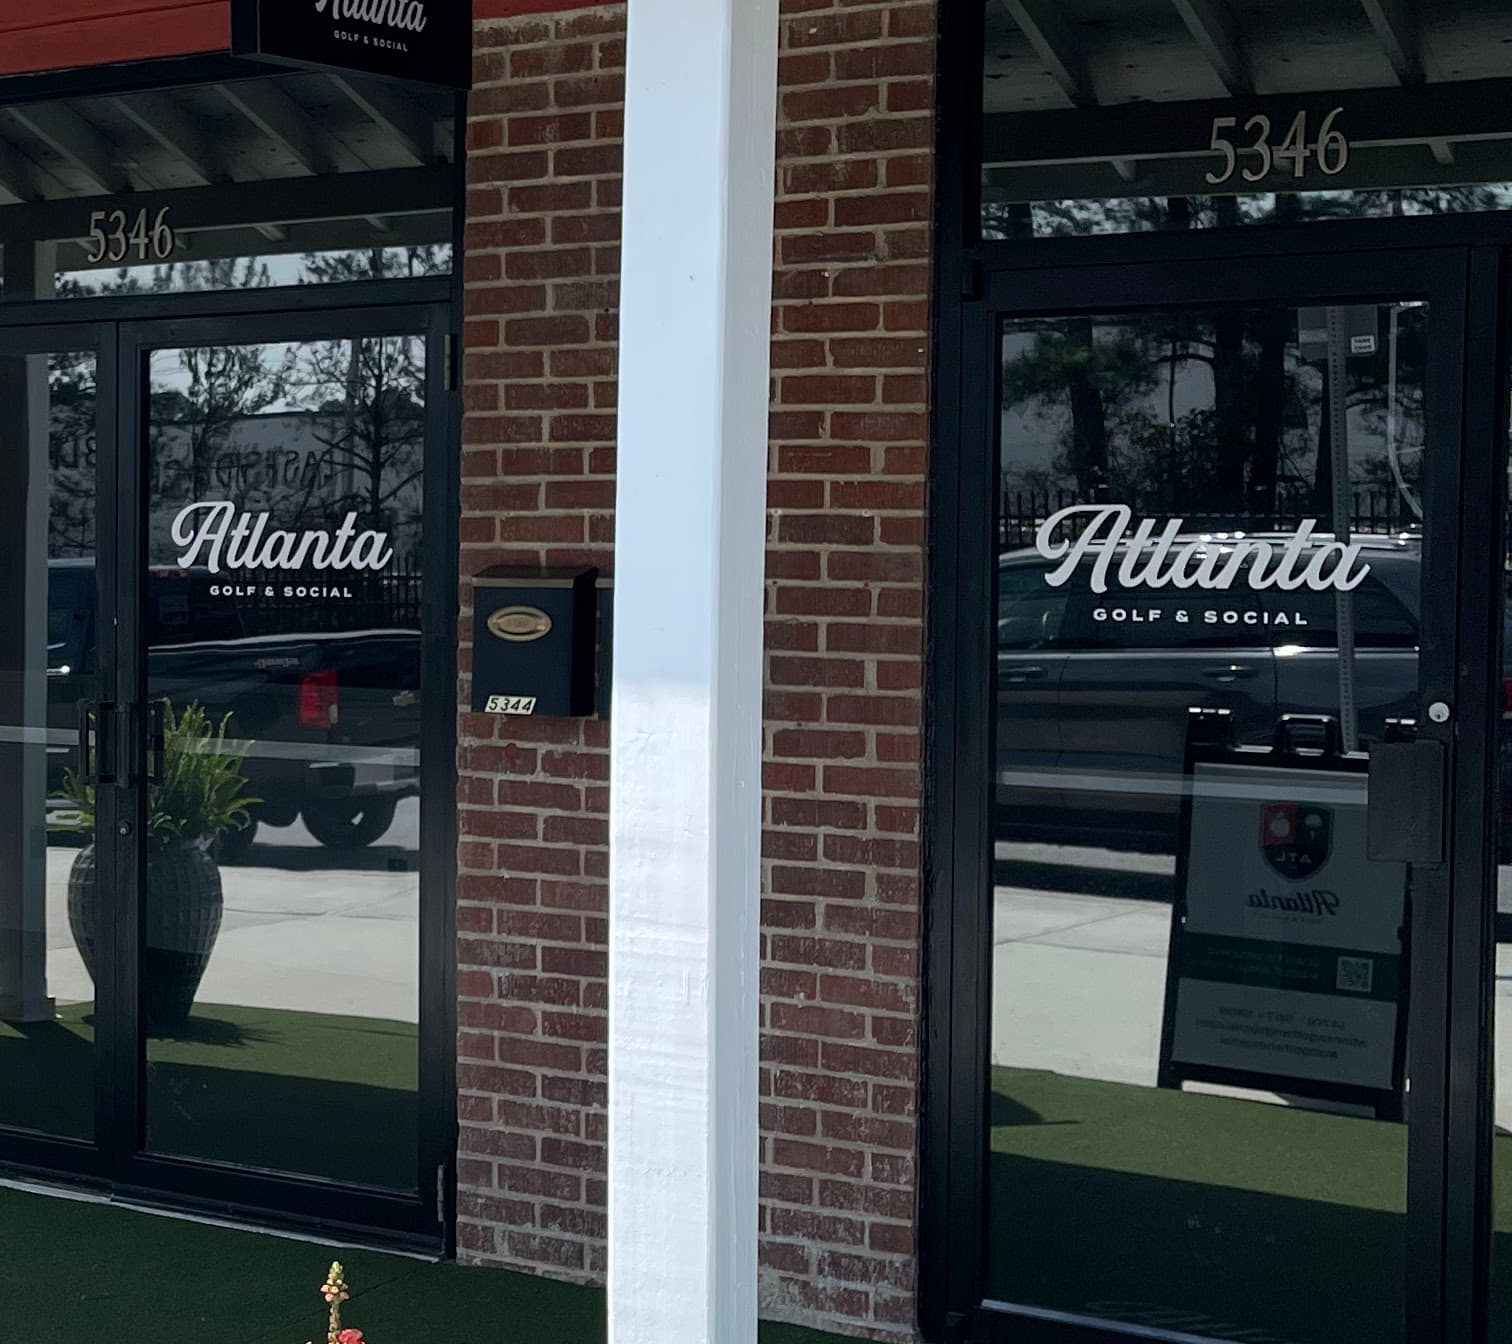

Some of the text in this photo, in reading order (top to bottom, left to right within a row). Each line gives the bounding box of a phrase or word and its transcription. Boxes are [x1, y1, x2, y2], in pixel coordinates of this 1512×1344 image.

[333, 30, 409, 52] GOLF & SOCIAL
[1205, 107, 1348, 184] 5346
[88, 207, 173, 263] 5346
[171, 500, 393, 574] Atlanta
[1035, 503, 1371, 594] Atlanta
[209, 585, 353, 599] GOLF & SOCIAL
[1092, 608, 1308, 626] GOLF & SOCIAL
[488, 697, 533, 712] 5344
